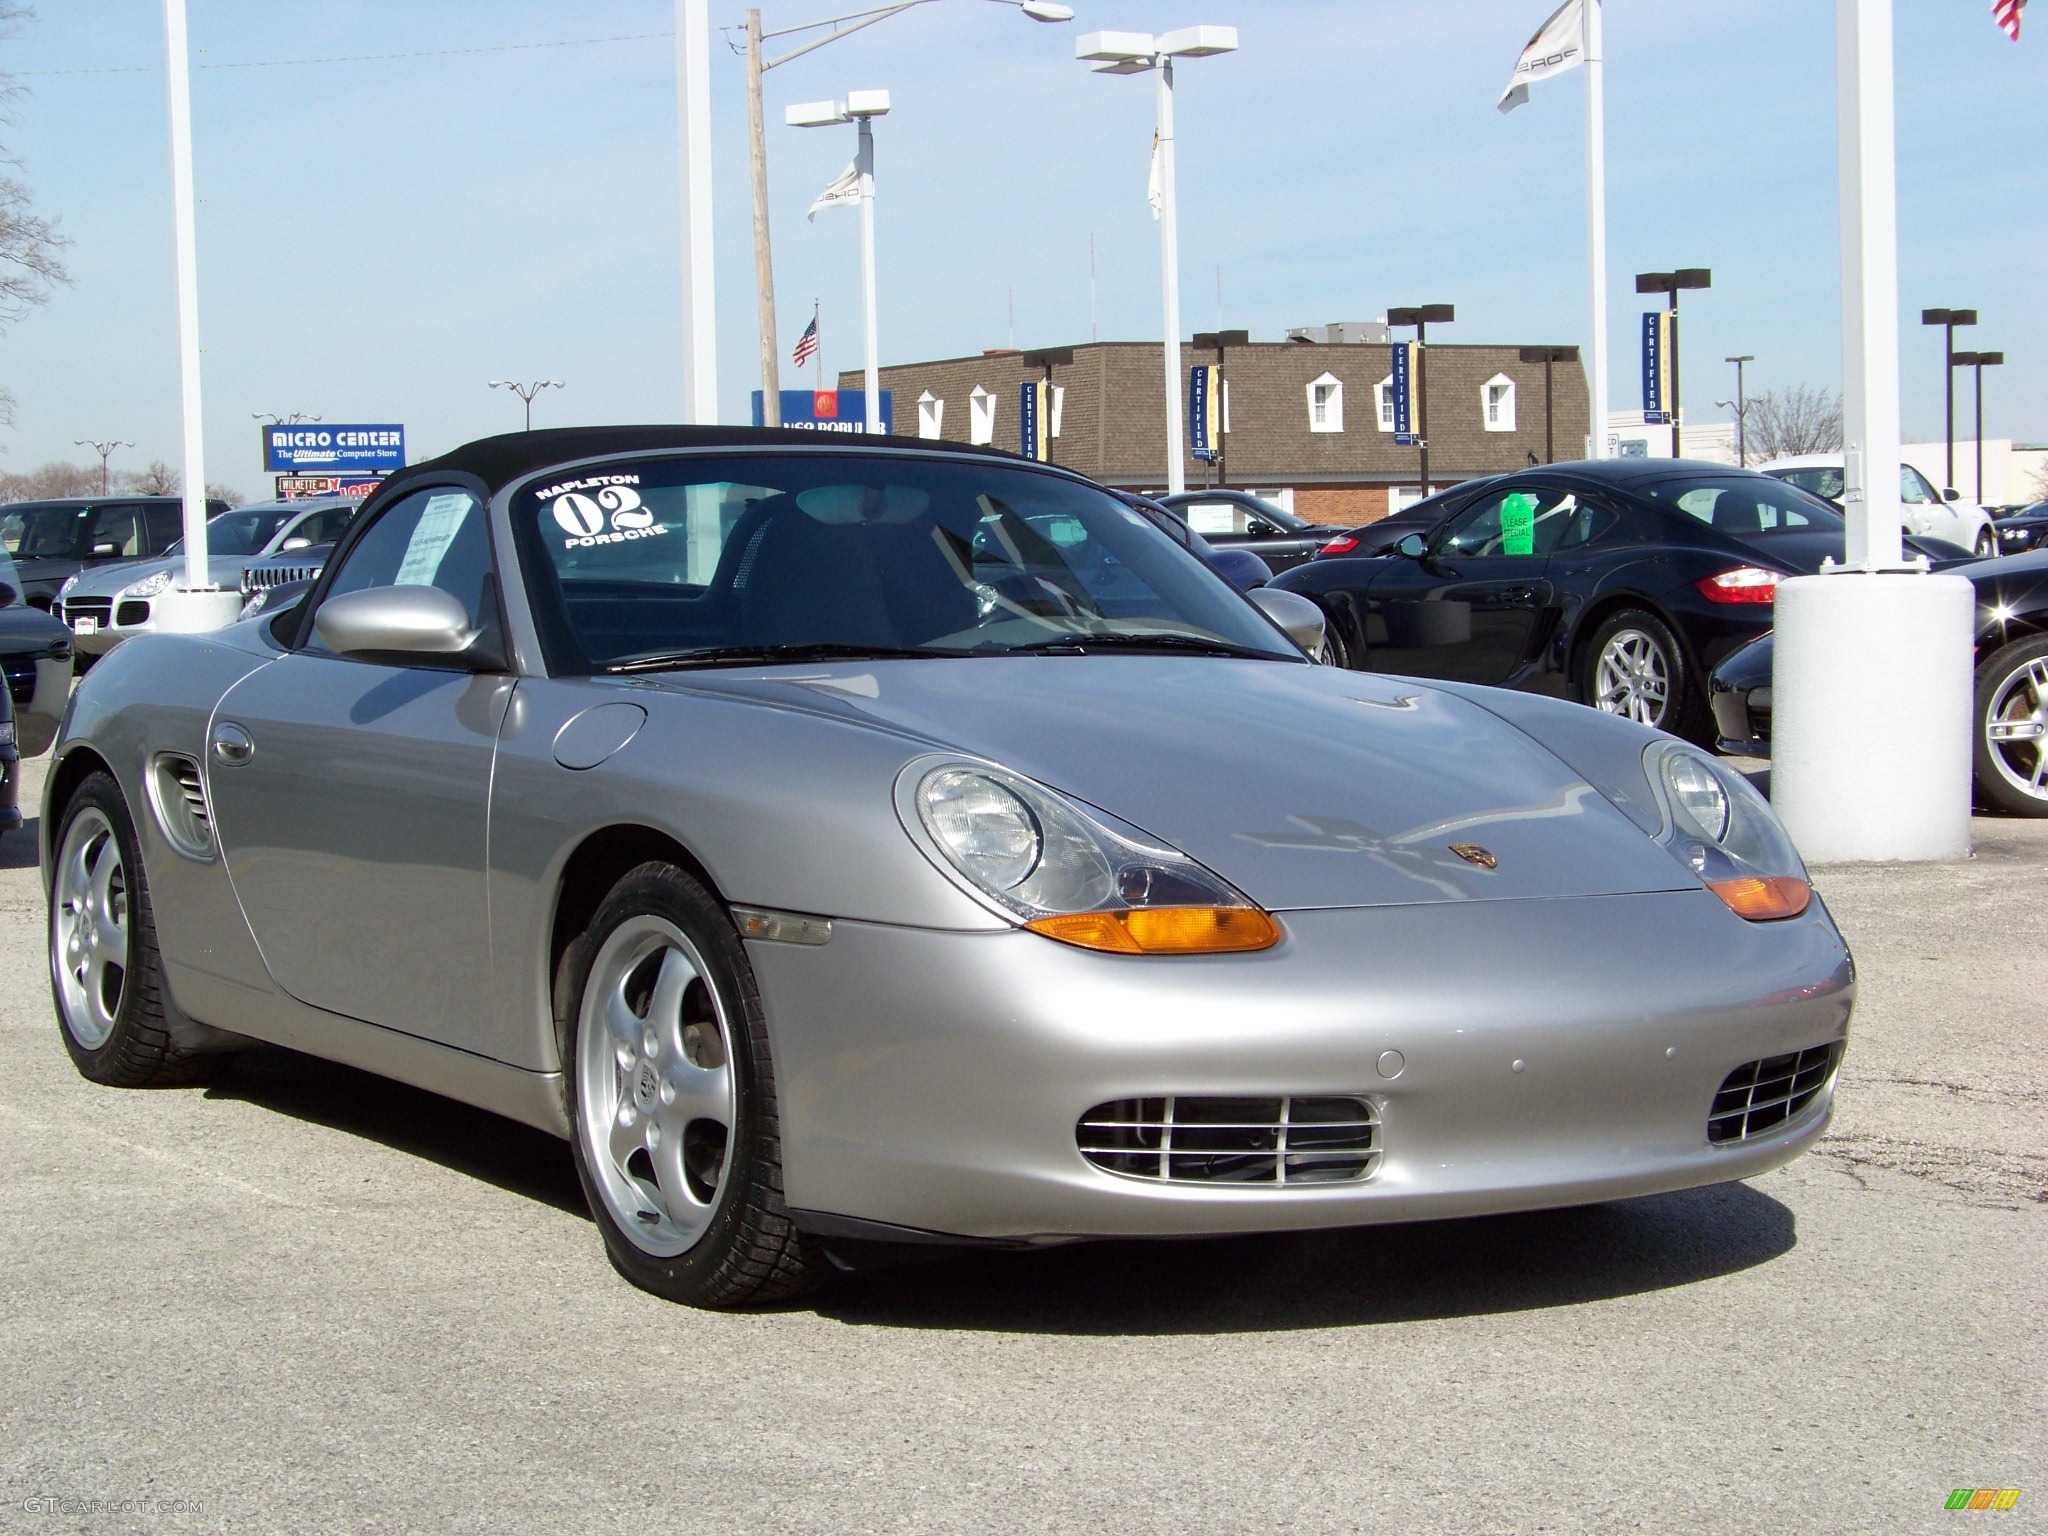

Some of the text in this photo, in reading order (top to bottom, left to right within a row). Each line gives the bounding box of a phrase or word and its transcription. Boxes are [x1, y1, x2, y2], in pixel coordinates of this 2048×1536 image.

[1648, 316, 1656, 409] CERTIFIED
[1398, 347, 1406, 432] CERTIFIED
[272, 431, 401, 447] MICRO CENTER
[277, 449, 398, 459] The Ultimate Computer Store
[282, 479, 318, 490] WILMETTE
[535, 475, 640, 500] NAPLETON
[553, 486, 654, 537] 02
[1506, 517, 1528, 527] LEASE
[565, 524, 669, 549] PORSCHE
[1503, 528, 1531, 538] SPECIAL
